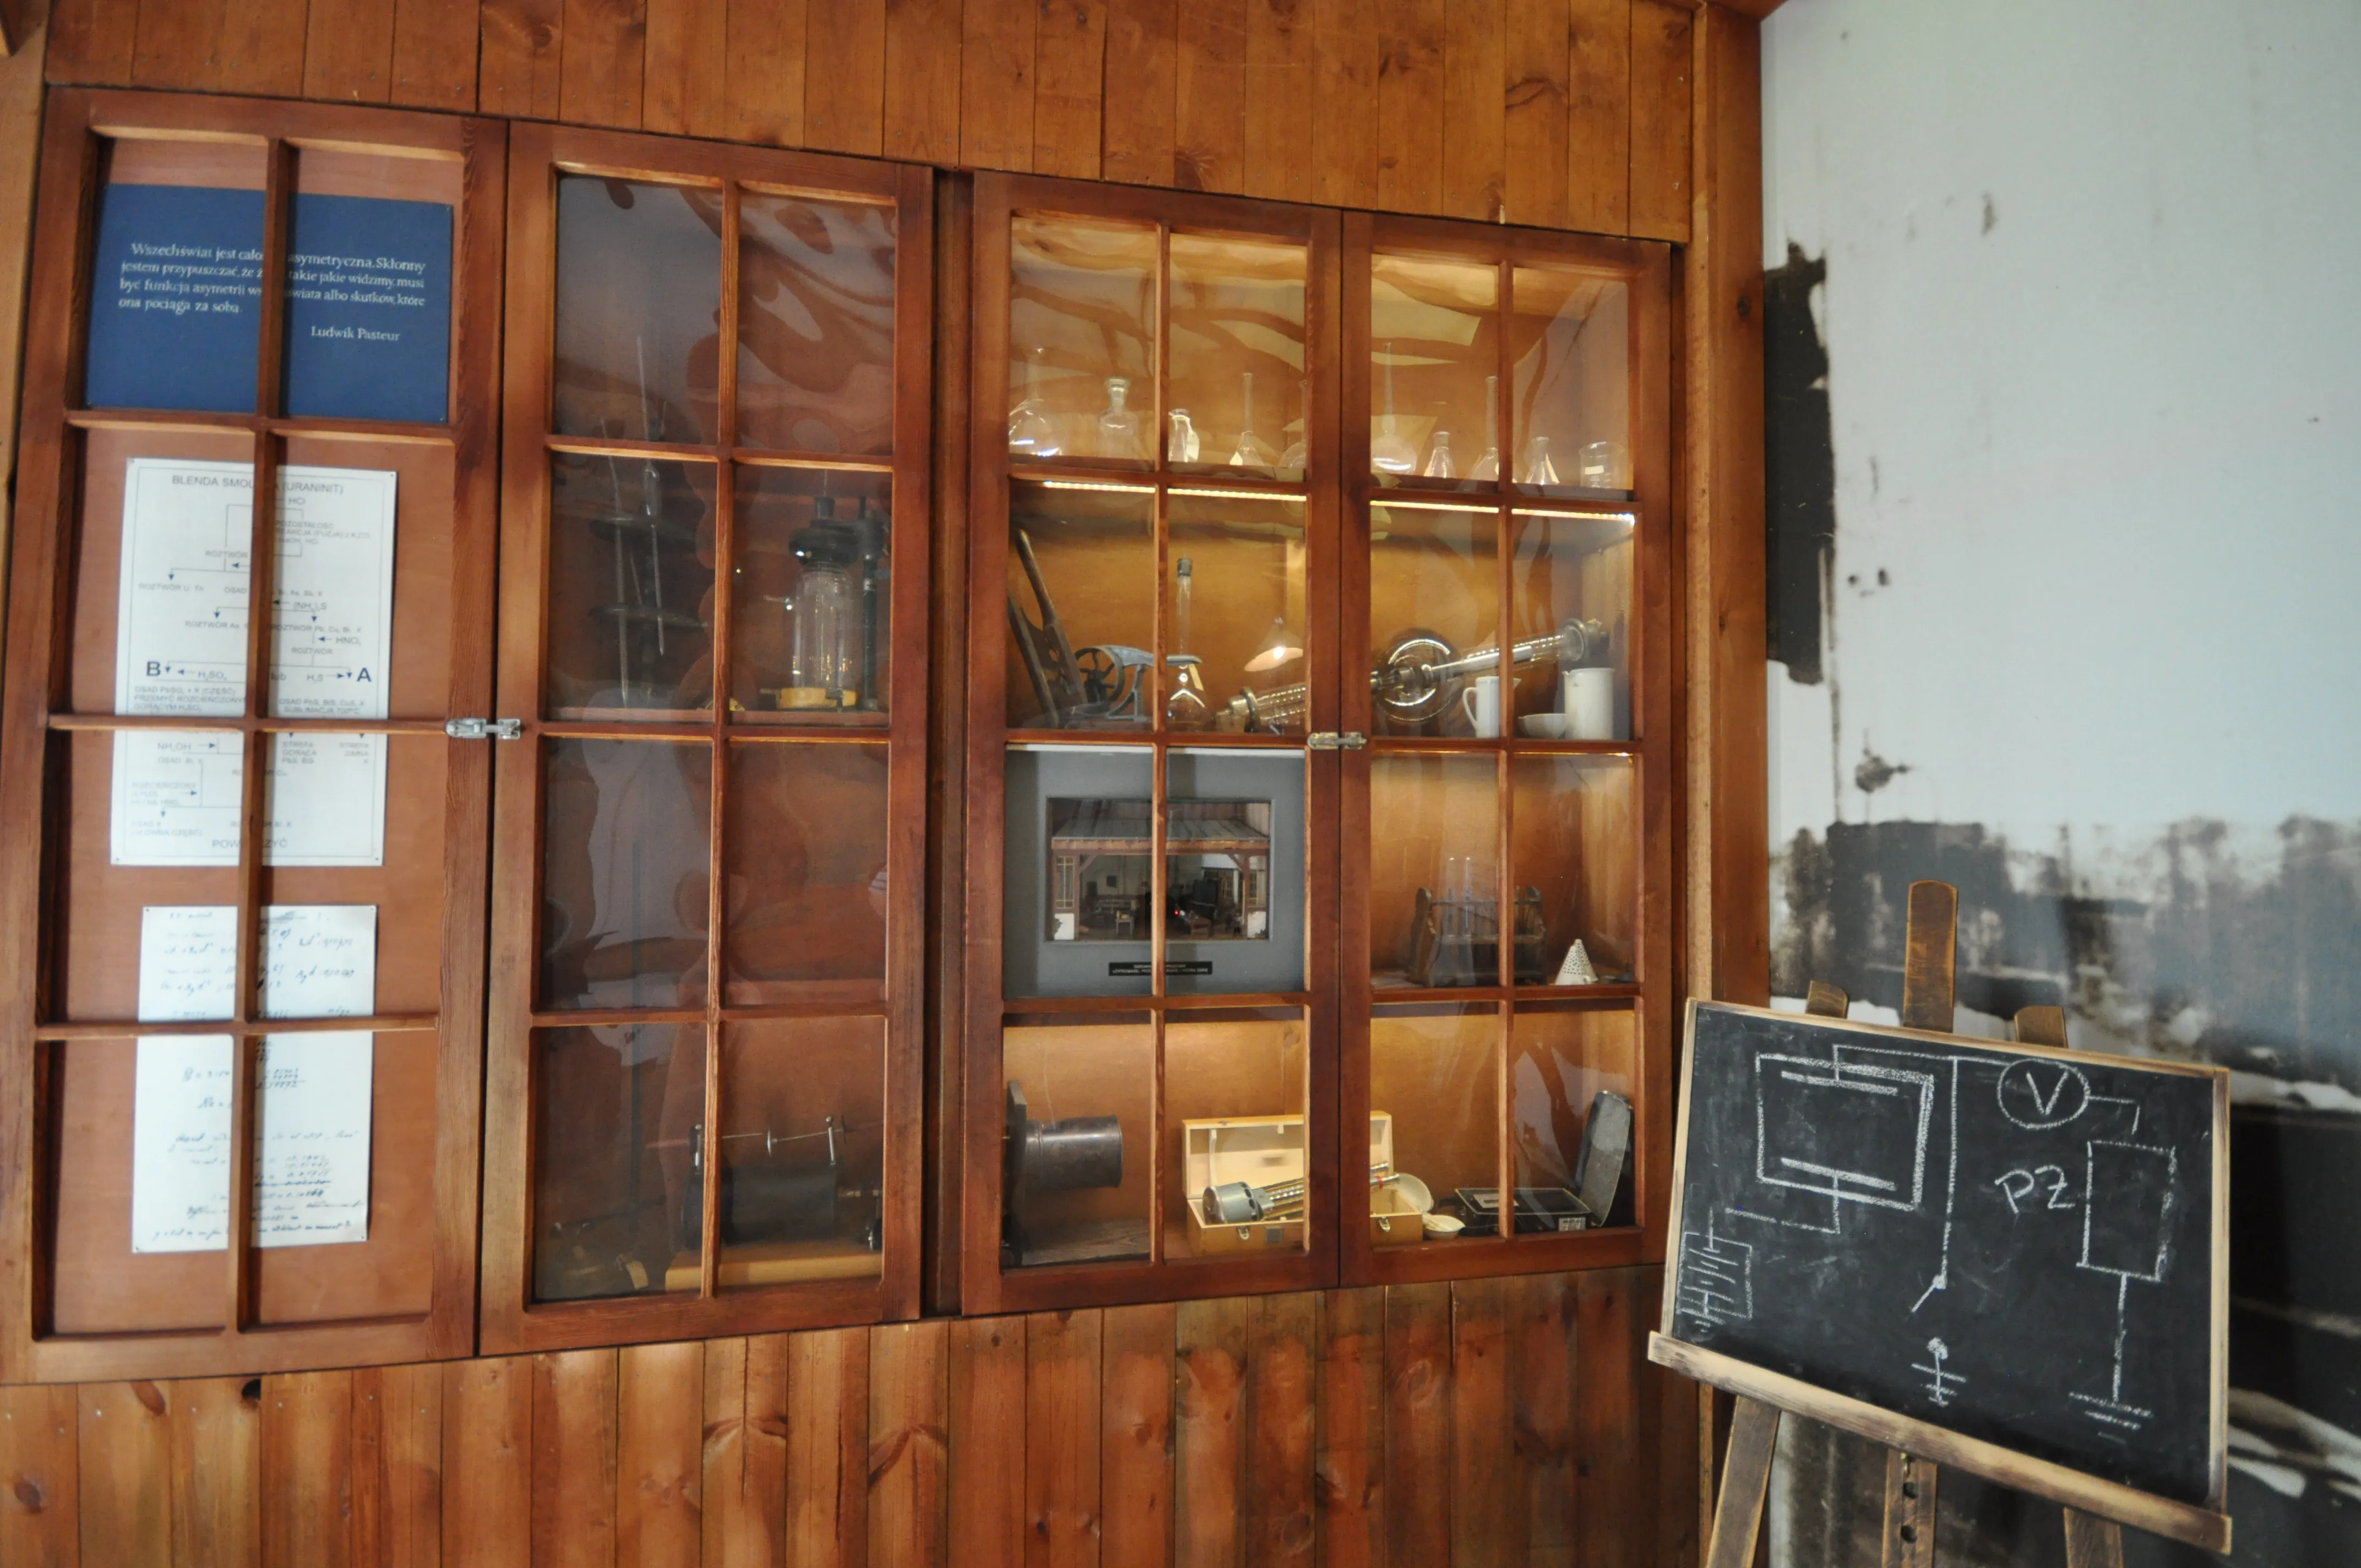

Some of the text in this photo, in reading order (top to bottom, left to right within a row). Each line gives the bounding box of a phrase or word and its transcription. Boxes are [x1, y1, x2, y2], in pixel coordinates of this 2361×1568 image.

[215, 247, 236, 263] jest
[376, 257, 426, 275] Skłonny
[121, 260, 160, 275] jestem
[288, 269, 318, 282] takie
[319, 270, 346, 286] jakie
[397, 278, 424, 288] musi
[119, 277, 141, 293] być
[193, 284, 245, 297] asymetrii
[324, 288, 349, 301] albo
[398, 293, 425, 306] które
[118, 299, 142, 308] ona
[195, 302, 209, 312] za
[311, 326, 400, 341] Ludwik Pasteur
[172, 475, 219, 487] BLENDA
[283, 481, 344, 495] (URANINIT)
[146, 661, 161, 677] B
[356, 667, 372, 683] A
[2026, 1070, 2070, 1117] V
